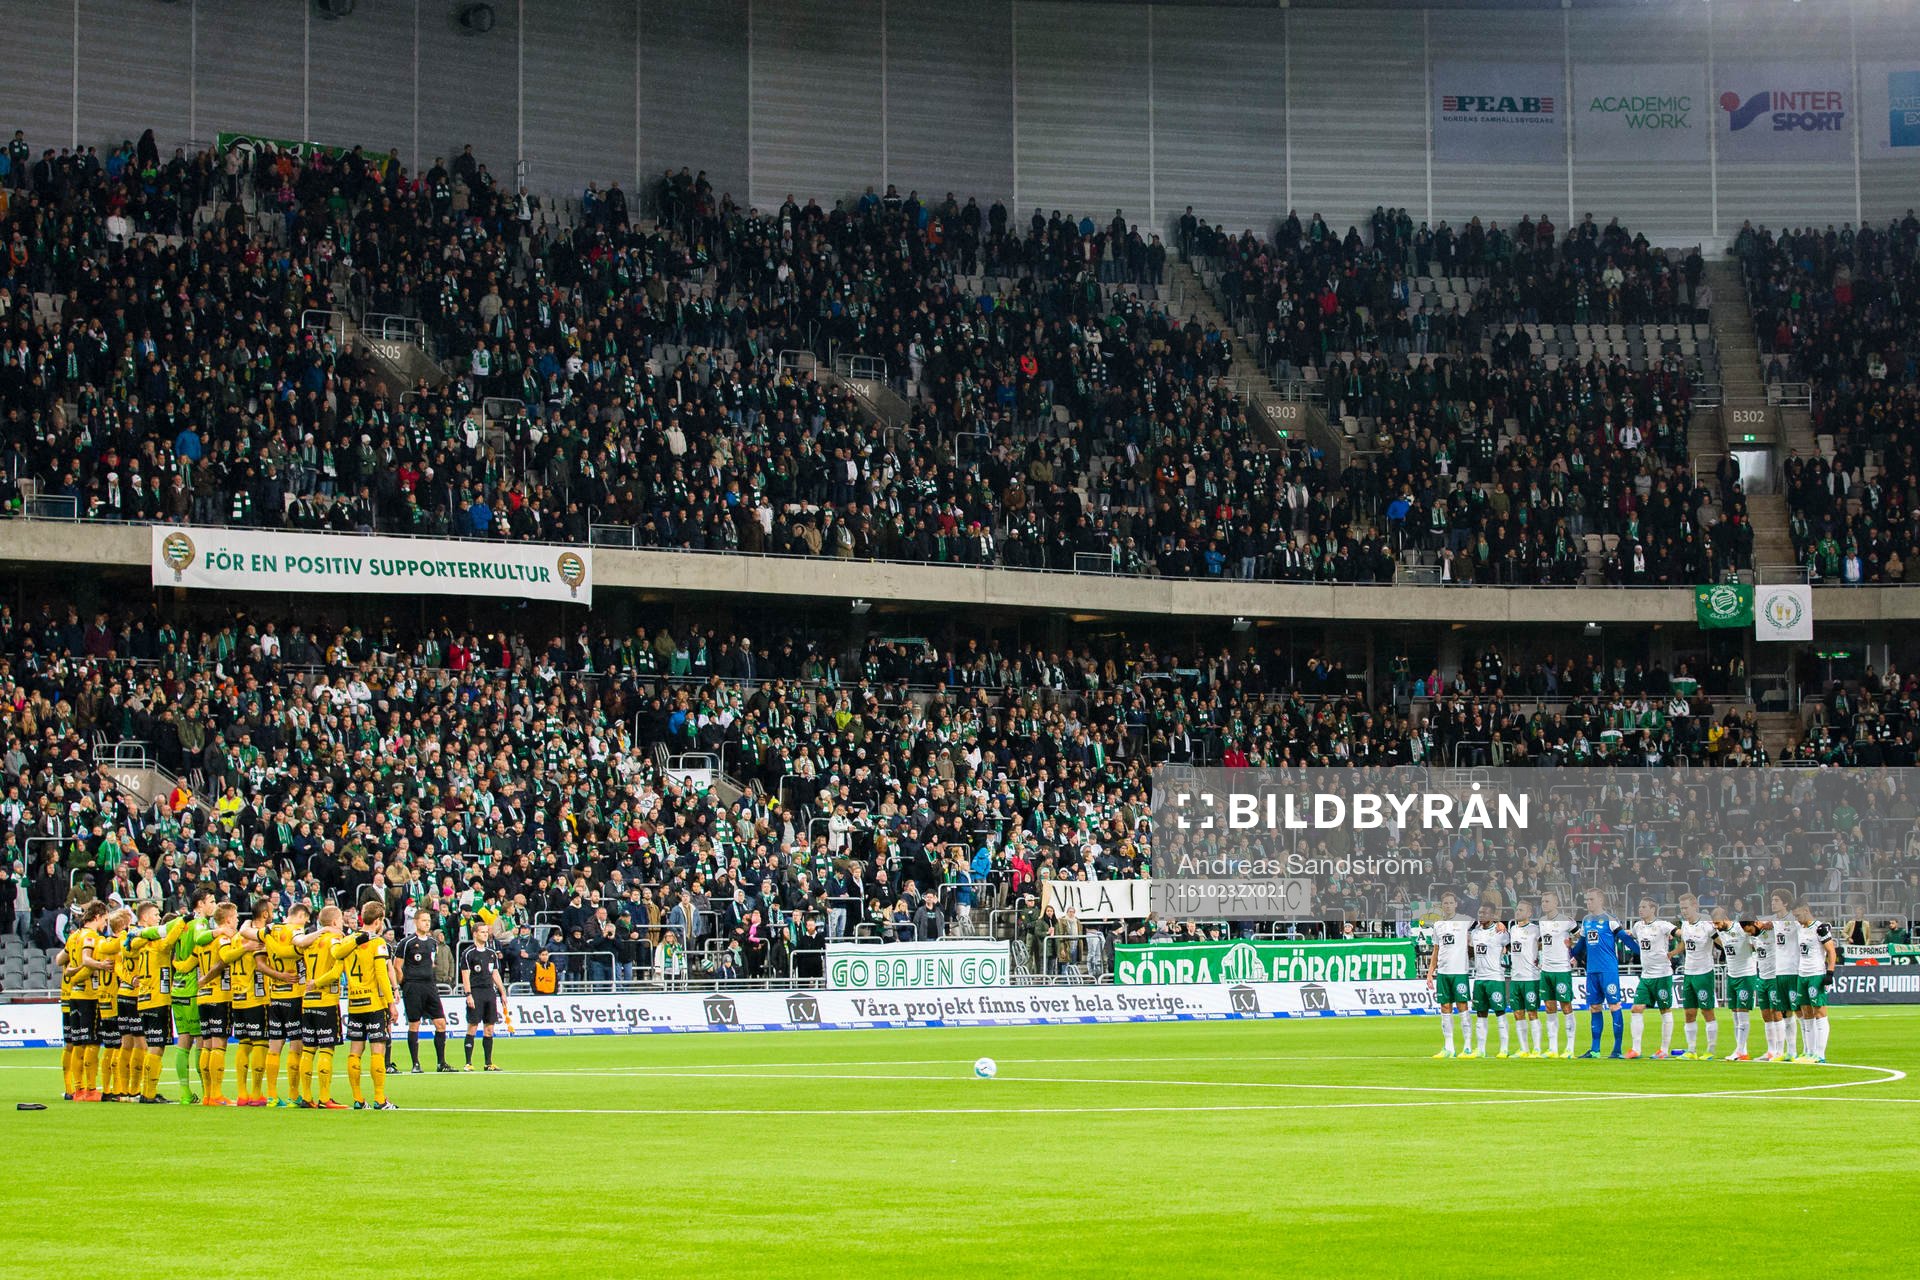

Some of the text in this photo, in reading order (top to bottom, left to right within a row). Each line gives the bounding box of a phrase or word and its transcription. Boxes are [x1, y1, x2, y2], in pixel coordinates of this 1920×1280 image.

[1456, 96, 1541, 113] PEAB
[1589, 96, 1691, 112] ACADEMIC
[1773, 91, 1842, 110] INTER
[1625, 113, 1692, 129] WORK.
[1772, 112, 1844, 131] SPORT
[1733, 410, 1765, 423] B302
[205, 547, 551, 583] FÖR EN POSITIV SUPPORTERKULTUR
[1052, 883, 1114, 913] VILA
[1149, 882, 1201, 913] FRID
[350, 954, 363, 983] 4
[832, 957, 1006, 987] GO BAJEN GO!
[1118, 948, 1408, 984] SÖDRA FÖRORTER
[1826, 975, 1920, 993] ASTER PUMA
[851, 992, 1203, 1021] Våra projekt finns över hela Sverige...
[1355, 987, 1438, 1008] Våra proj
[517, 1004, 566, 1024] hela
[570, 1003, 673, 1027] Sverige...
